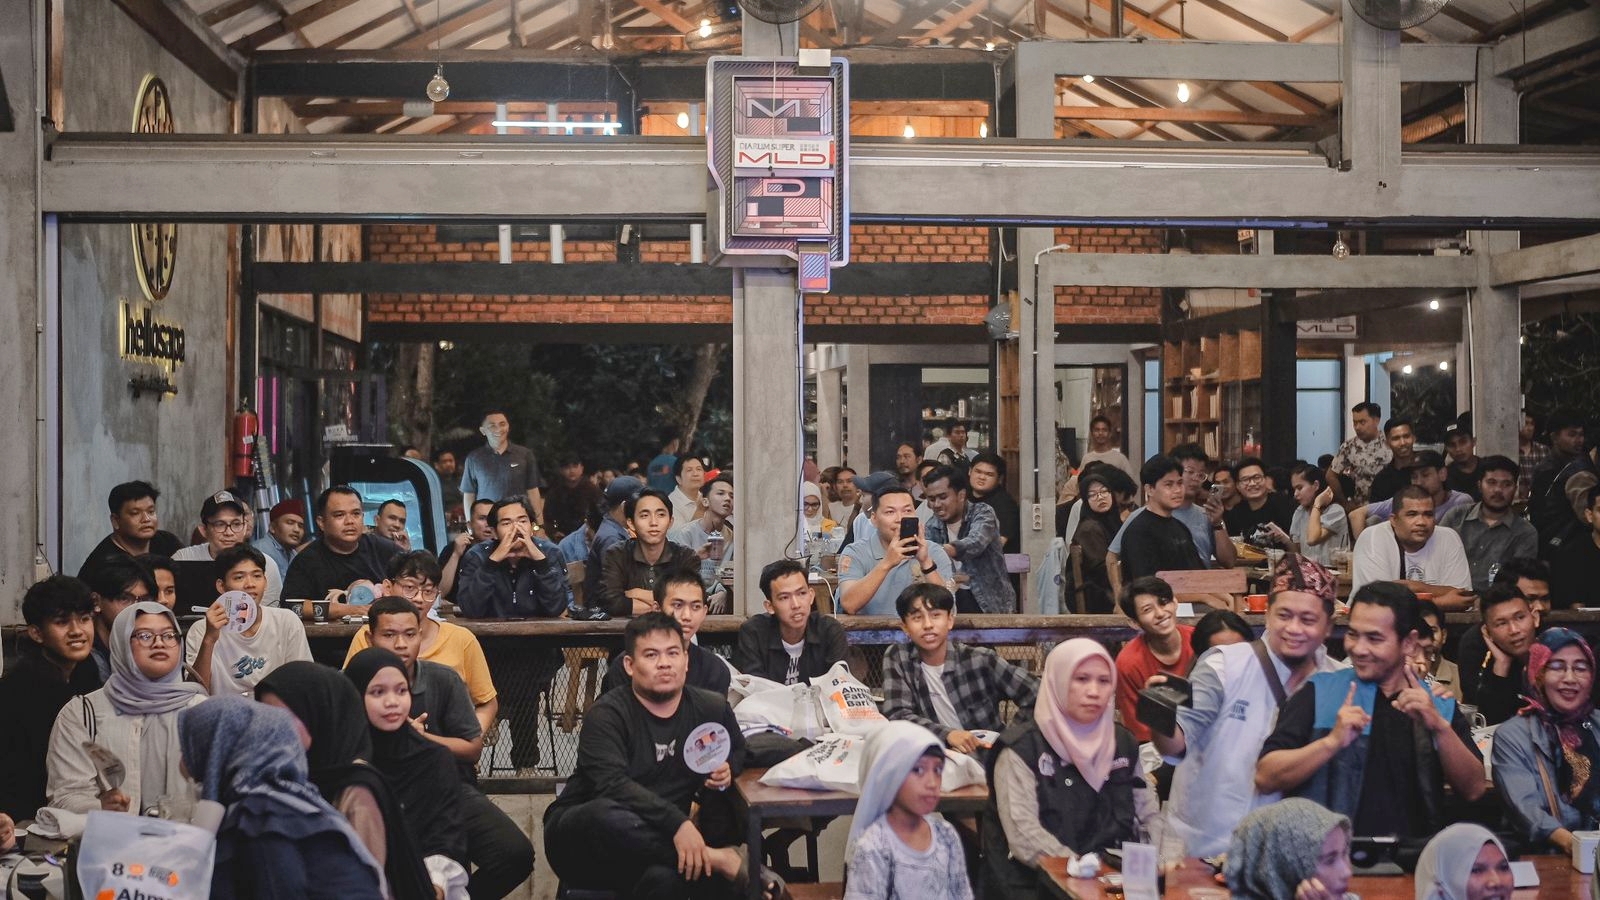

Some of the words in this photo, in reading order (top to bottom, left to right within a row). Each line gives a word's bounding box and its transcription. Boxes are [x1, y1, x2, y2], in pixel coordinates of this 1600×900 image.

[771, 143, 795, 151] SUPER
[739, 151, 826, 164] MLD
[112, 862, 124, 876] 8
